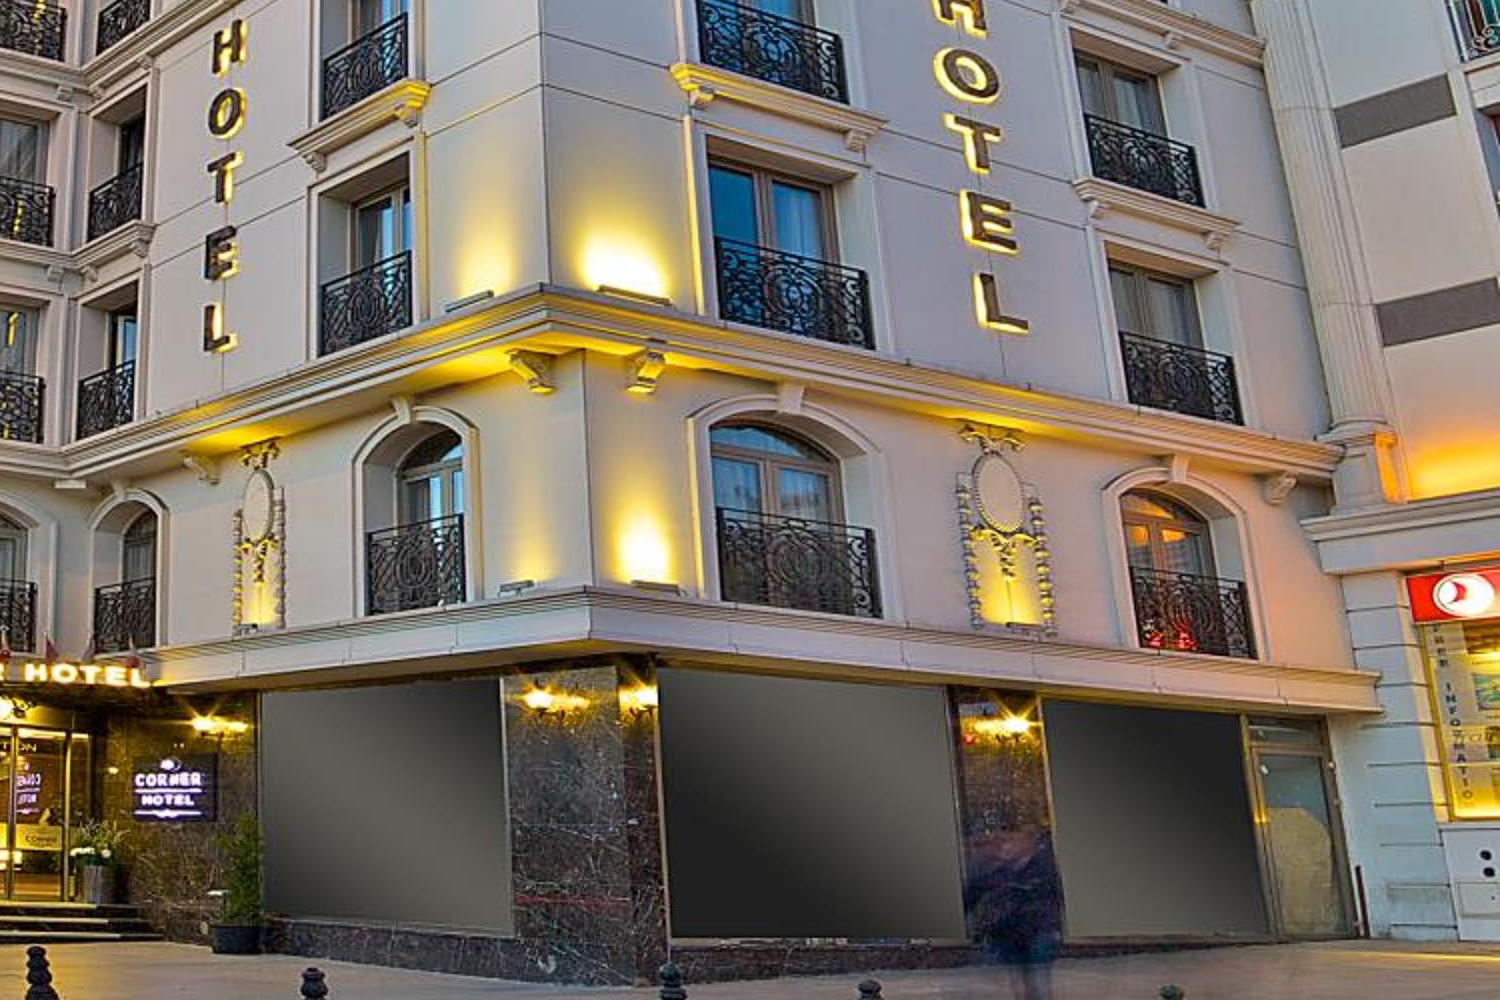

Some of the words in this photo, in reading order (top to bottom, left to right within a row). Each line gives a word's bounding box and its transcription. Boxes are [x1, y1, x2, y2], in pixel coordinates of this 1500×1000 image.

[203, 18, 243, 354] HOTEL
[23, 661, 151, 688] HOTEL
[135, 771, 202, 787] CORNER
[141, 794, 195, 807] HOTEL
